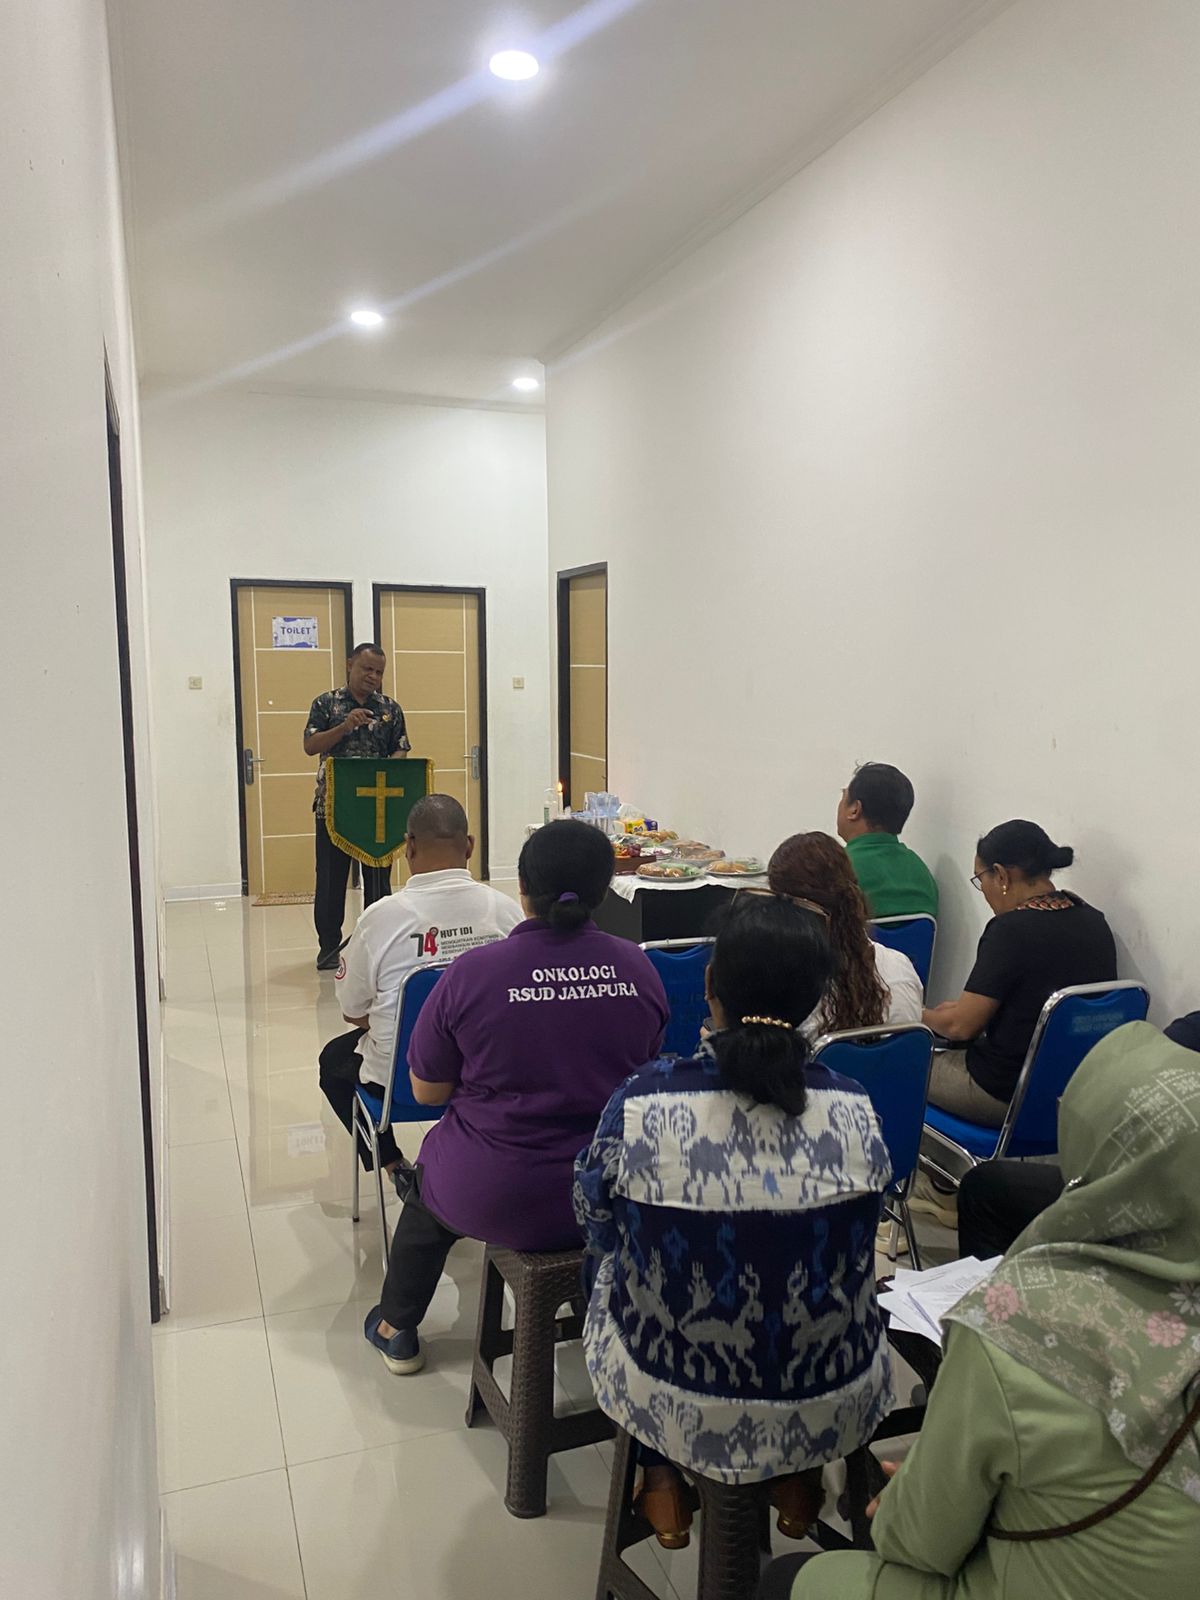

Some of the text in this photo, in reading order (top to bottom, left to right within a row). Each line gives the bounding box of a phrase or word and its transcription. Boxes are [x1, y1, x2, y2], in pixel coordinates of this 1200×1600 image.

[410, 926, 473, 957] 74 HUT IDI
[531, 965, 617, 983] ONKOLOGI
[507, 982, 639, 1003] RSUD JAYAPURA
